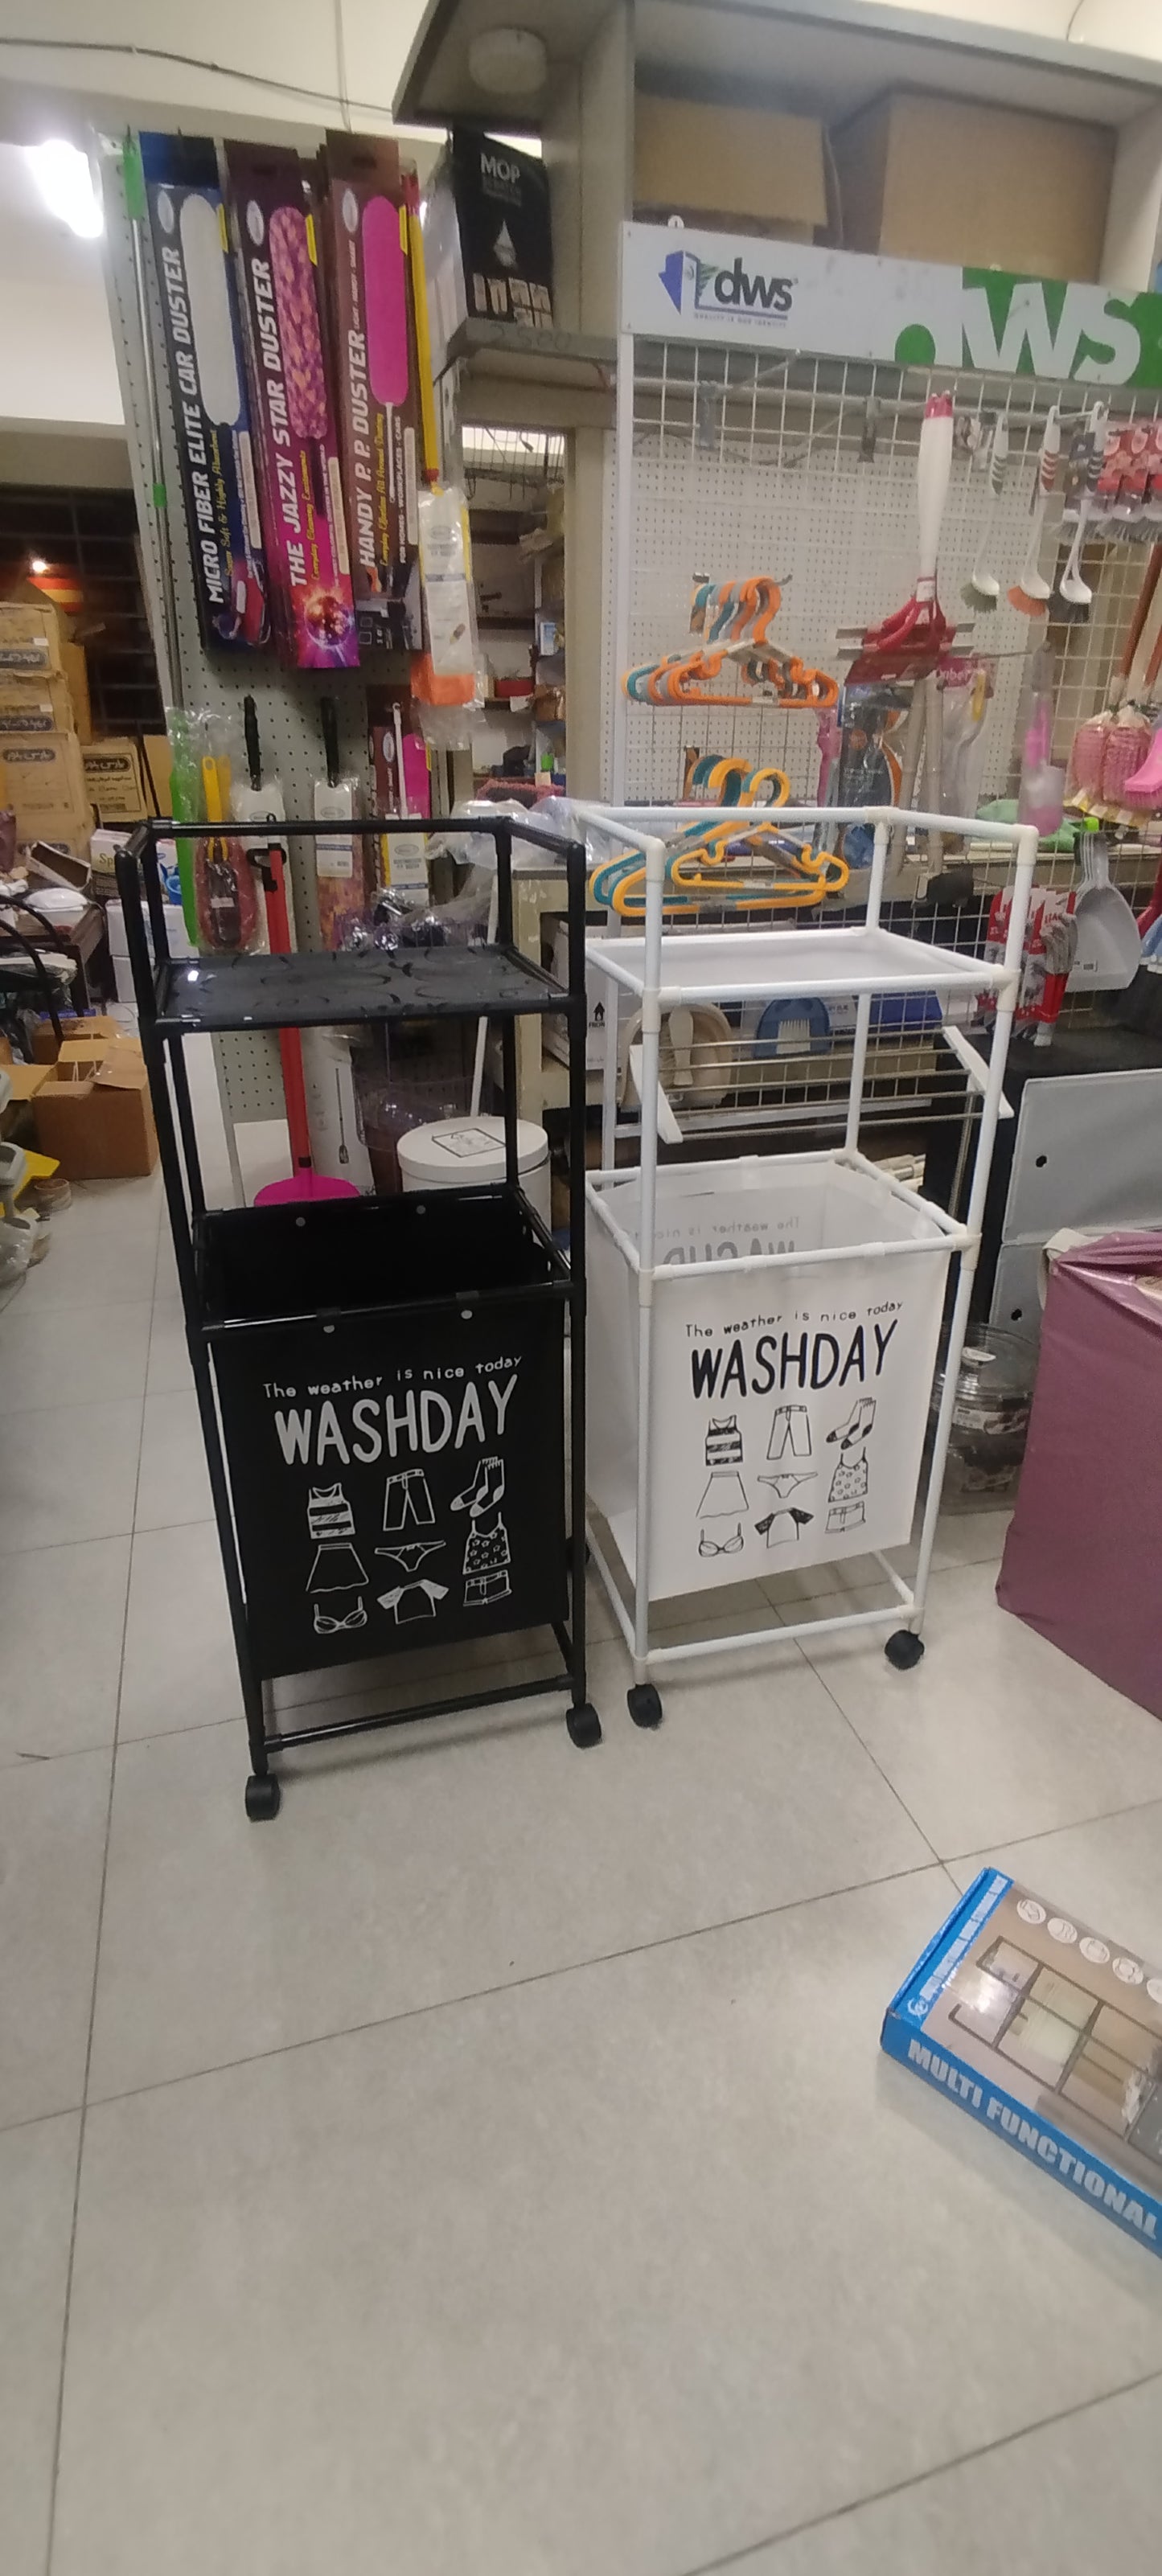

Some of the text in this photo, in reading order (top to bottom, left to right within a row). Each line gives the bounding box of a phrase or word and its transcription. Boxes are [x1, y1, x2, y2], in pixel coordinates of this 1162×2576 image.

[481, 154, 520, 183] MOP
[715, 257, 793, 311] dws
[162, 247, 224, 603] MICRO FIBER ELITE CAR DUSTER
[251, 258, 307, 586] THE JAZZY STAR DUSTER
[348, 330, 376, 568] HANDY P. P. DUSTER
[395, 447, 404, 507] WORKPLACES
[686, 1300, 903, 1337] The weather is nice today
[263, 1356, 522, 1398] The weather is nice today
[691, 1319, 898, 1399] WASHDAY
[274, 1373, 517, 1465] WASHDAY
[908, 2039, 1158, 2241] MULTI FUNCTIONAL
